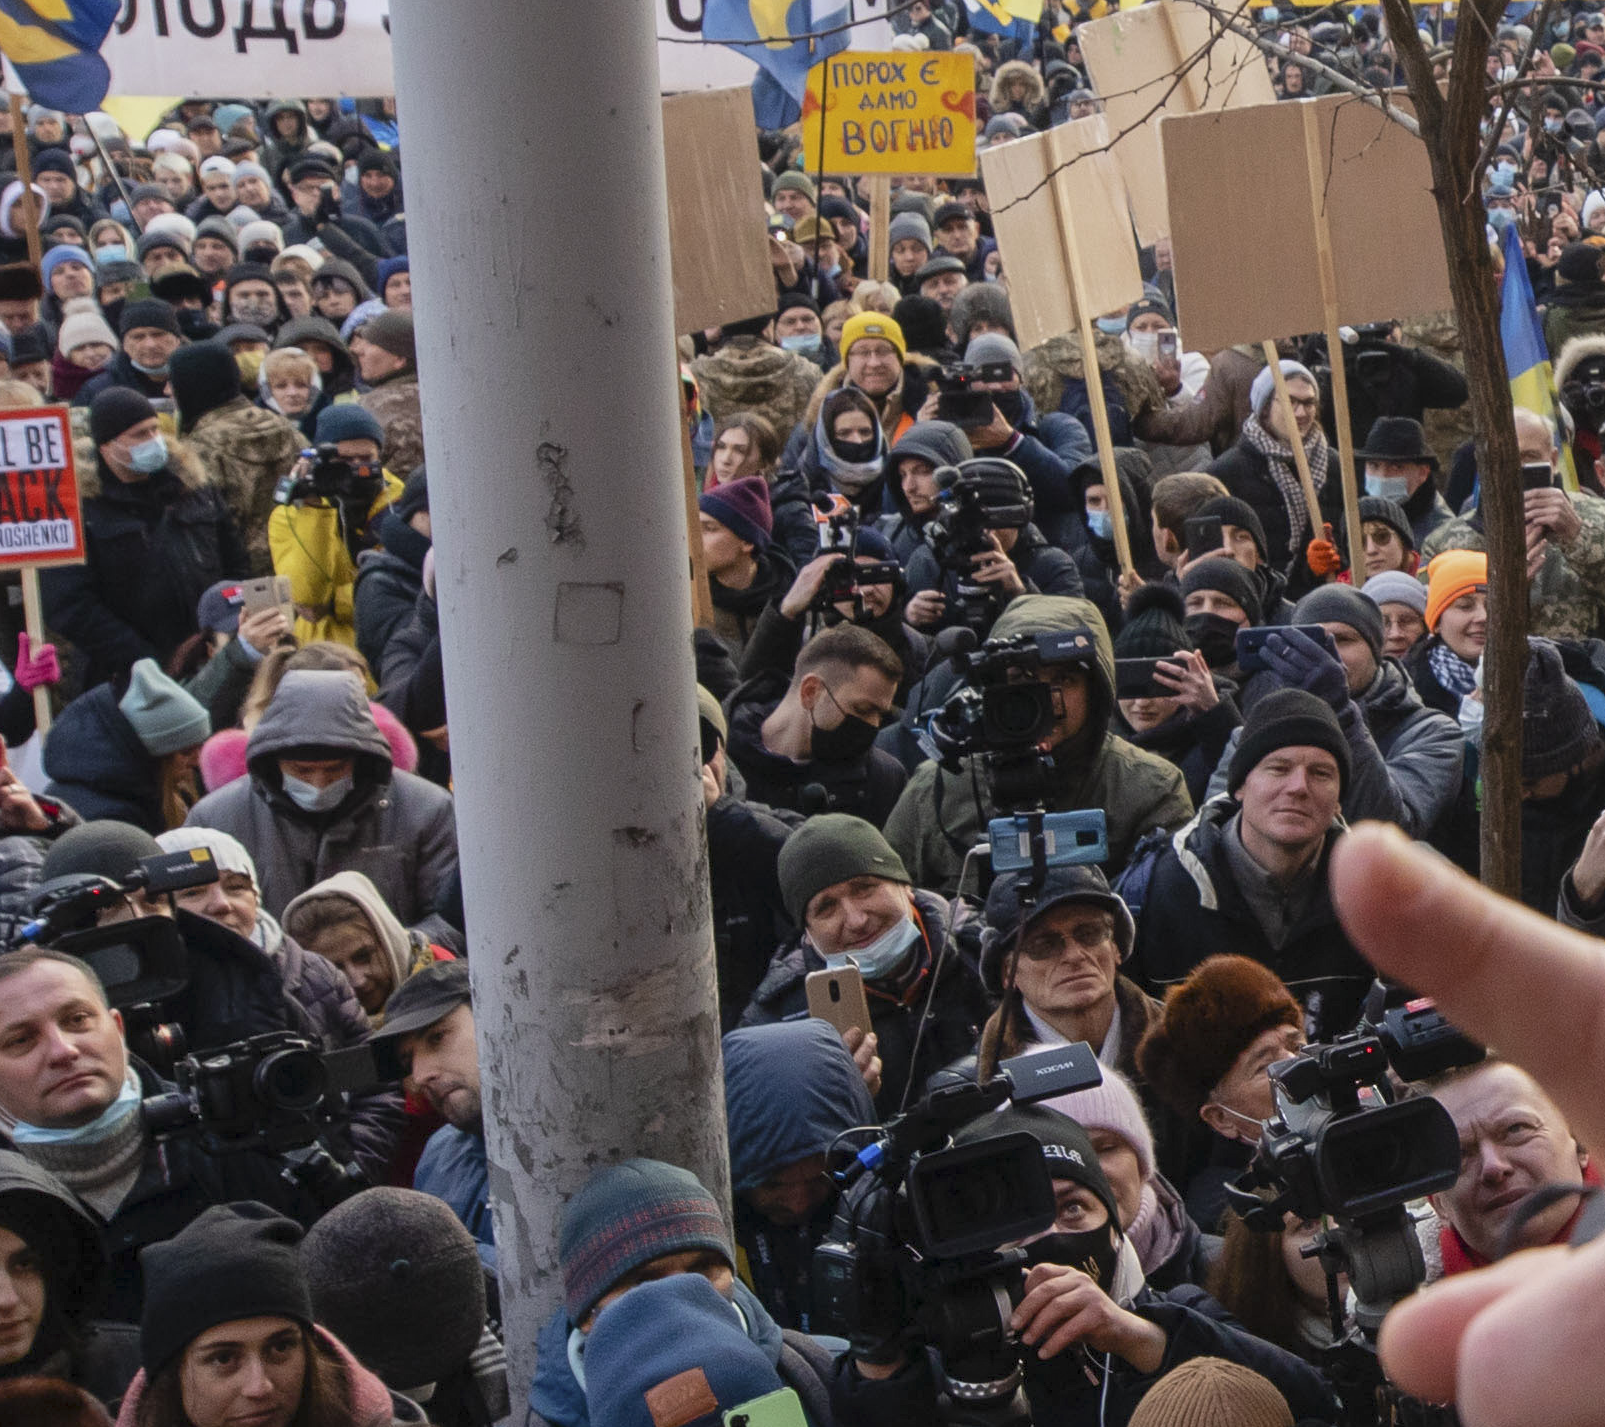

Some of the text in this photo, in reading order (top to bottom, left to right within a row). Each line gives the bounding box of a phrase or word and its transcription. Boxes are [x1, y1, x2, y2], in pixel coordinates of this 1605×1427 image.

[832, 59, 941, 89] ПОРОХ Є
[858, 89, 918, 111] ДАМО
[842, 115, 954, 156] ВОГНЮ
[24, 424, 61, 466] BE
